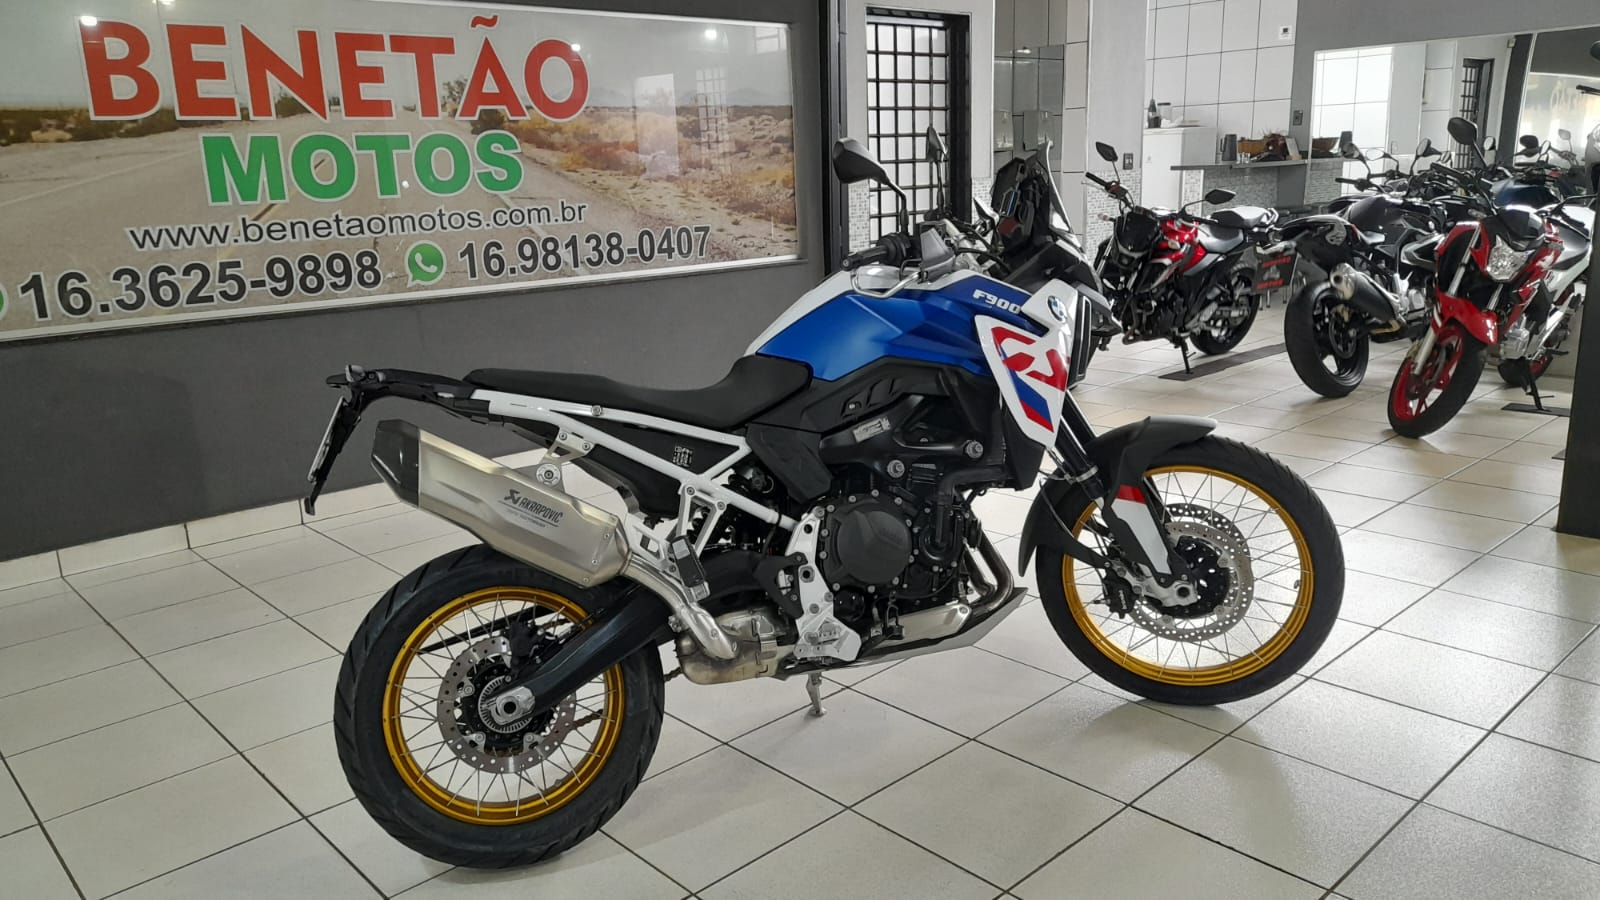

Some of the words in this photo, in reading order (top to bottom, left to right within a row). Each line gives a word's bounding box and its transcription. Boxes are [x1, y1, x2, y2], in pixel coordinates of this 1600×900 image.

[80, 15, 589, 122] BENETÃO
[201, 132, 523, 203] MOTOS
[130, 201, 586, 249] www.benetaomotos.com.br
[459, 226, 711, 279] 16.98138-0407
[19, 250, 382, 319] 16.3625-9898
[972, 289, 1021, 314] F900
